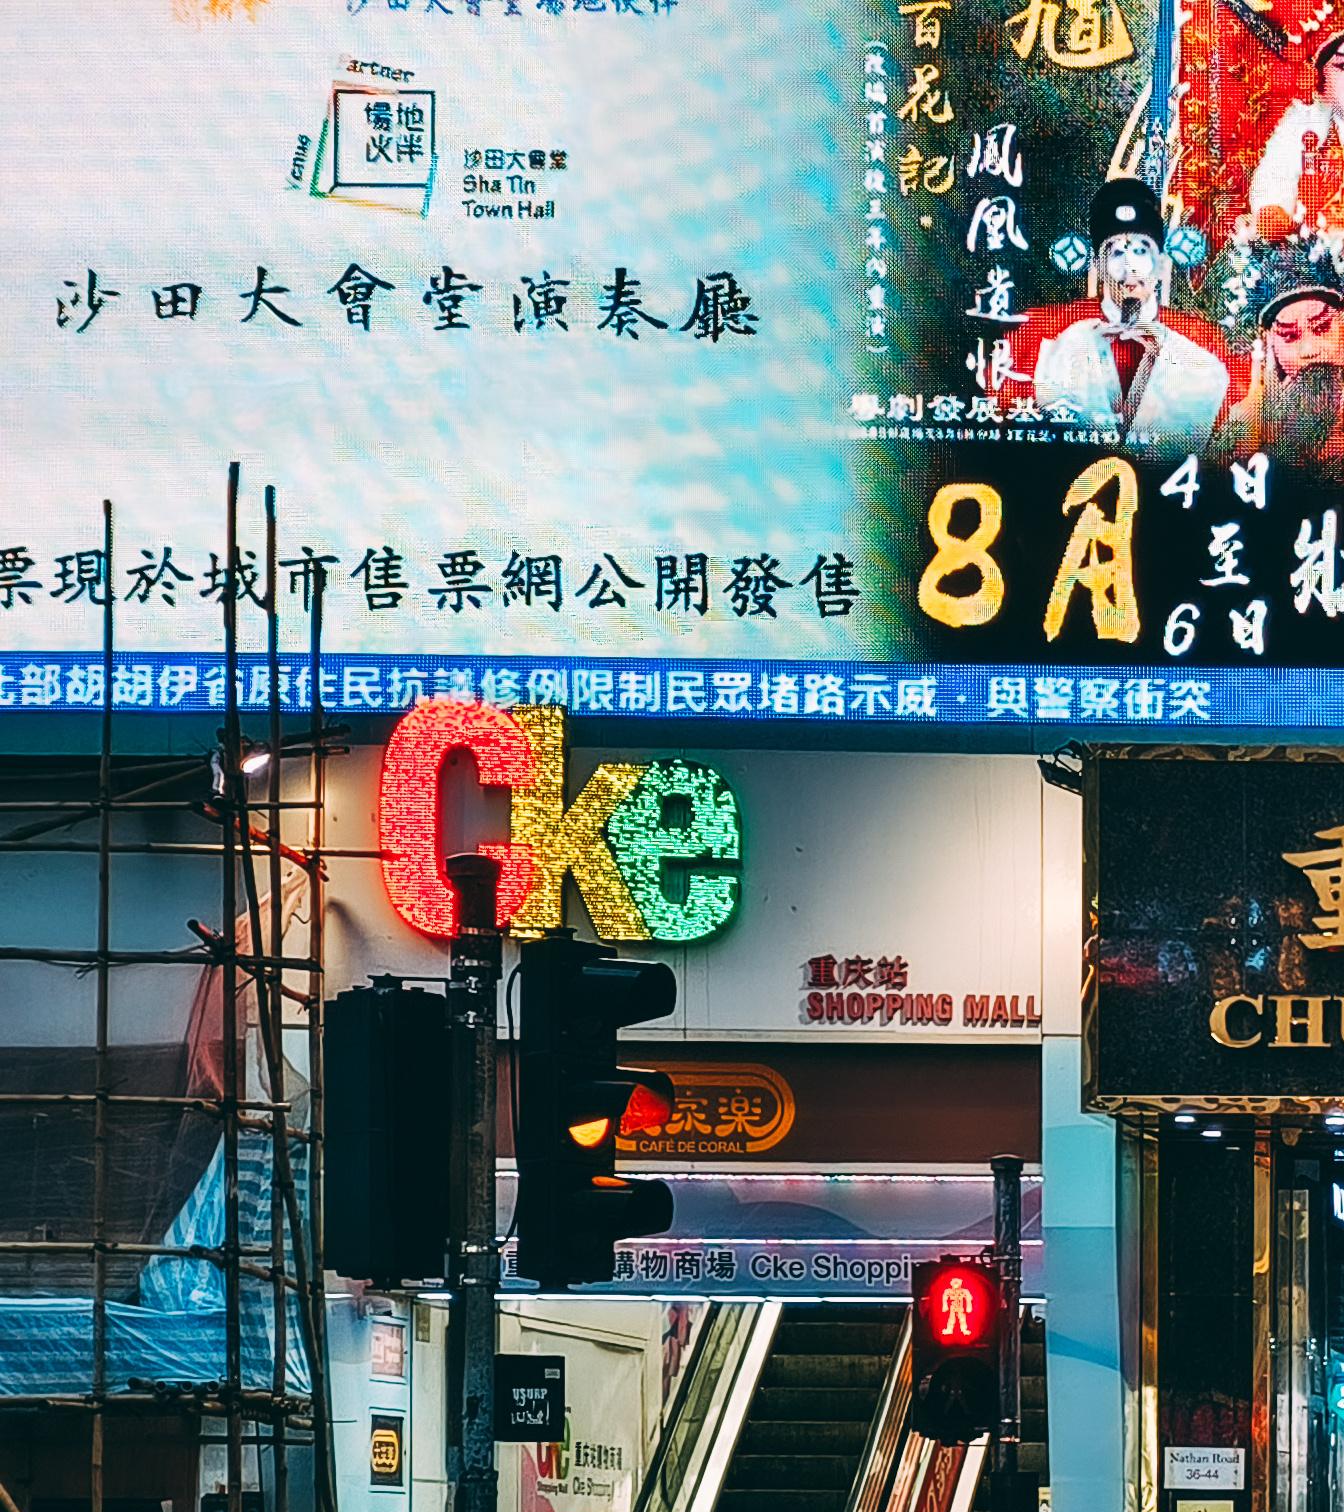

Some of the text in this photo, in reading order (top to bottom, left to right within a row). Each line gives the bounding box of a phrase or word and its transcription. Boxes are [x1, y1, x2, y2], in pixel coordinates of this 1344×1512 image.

[364, 102, 425, 132] 場地
[365, 134, 425, 165] 伙伴
[462, 175, 501, 194] Sha
[462, 199, 556, 219] Town Hall
[55, 263, 758, 343] 沙田大會堂演奏廳
[917, 456, 1142, 644] 8月
[1200, 525, 1250, 588] 至
[379, 697, 742, 941] Cke
[807, 953, 909, 991] 重庆站
[807, 991, 1041, 1024] SHOPPING MALL
[677, 1140, 695, 1153] DE
[698, 1140, 745, 1154] CORAL
[750, 1253, 916, 1286] Cke Shoppi
[1170, 1452, 1240, 1464] Nathan Road
[1185, 1468, 1220, 1480] 36-44
